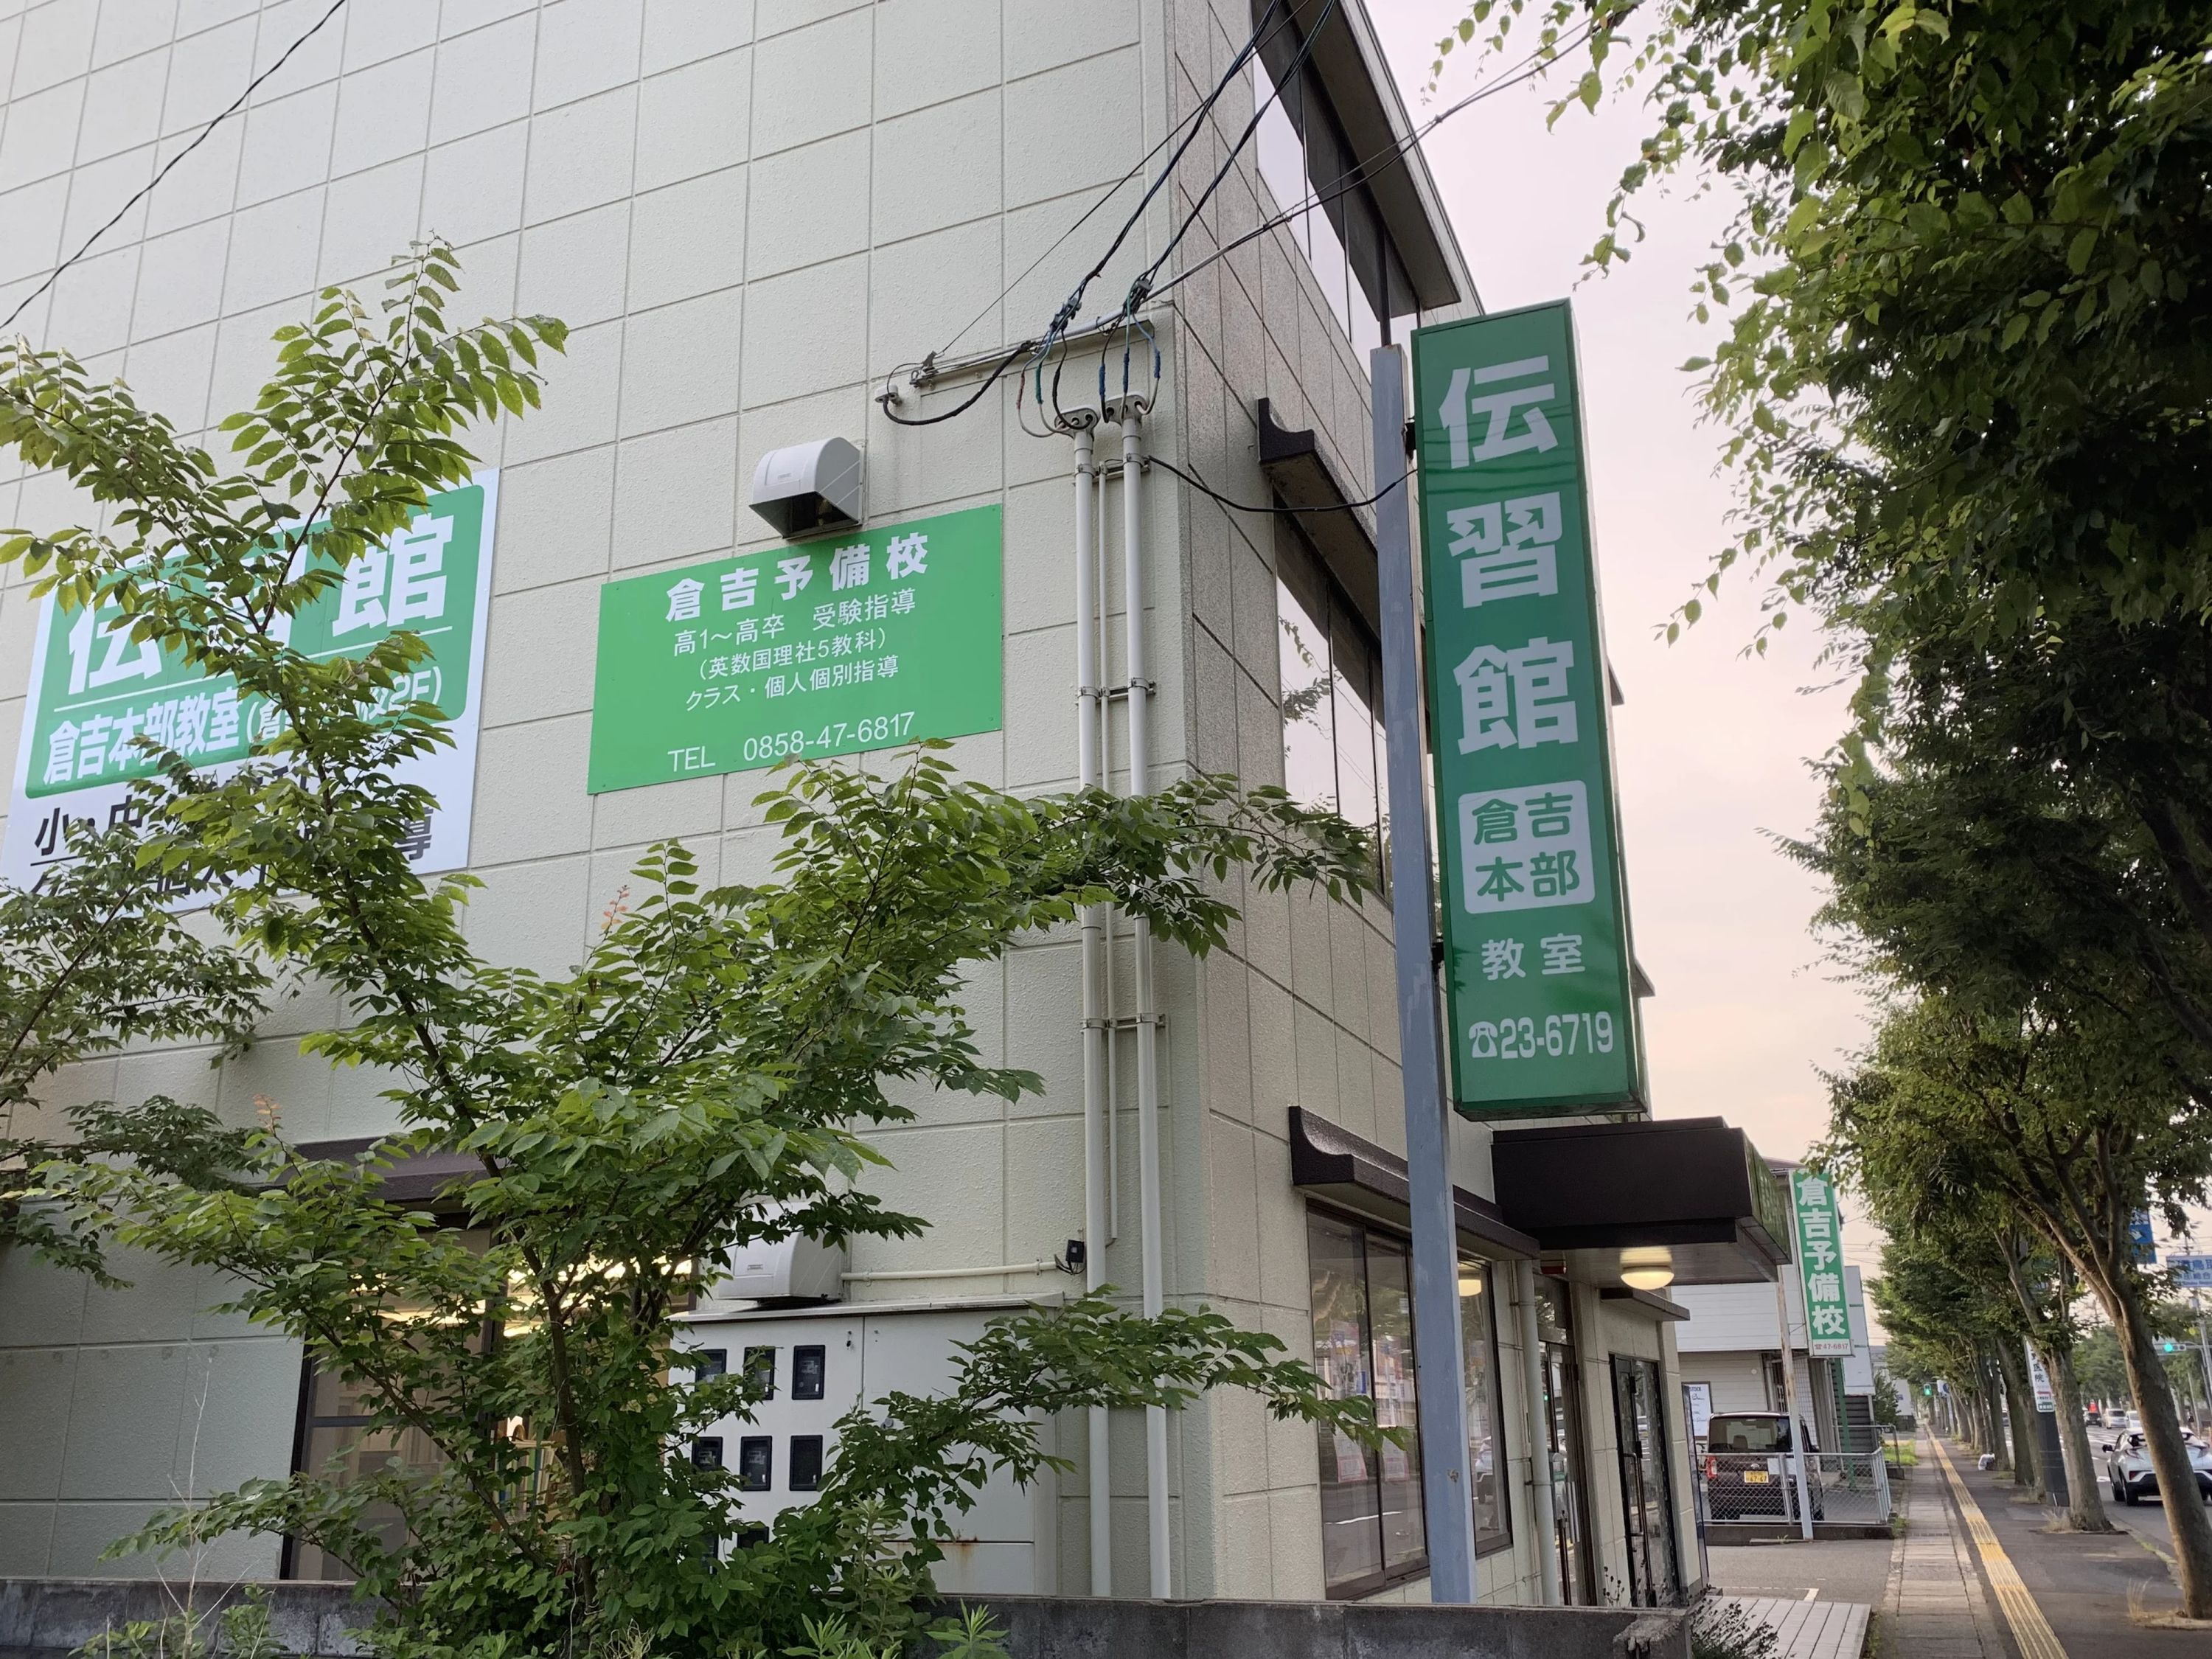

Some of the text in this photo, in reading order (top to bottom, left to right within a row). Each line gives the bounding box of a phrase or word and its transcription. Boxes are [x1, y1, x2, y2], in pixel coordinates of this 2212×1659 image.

[664, 532, 929, 622] 倉吉予備校
[1439, 355, 1578, 756] 伝習館
[813, 588, 917, 632] 受験指導
[686, 654, 899, 712] クラス・個人個別指導
[700, 629, 887, 682] (英数国理社5教科)
[667, 711, 916, 773] TEL 0858-47-6817
[1471, 791, 1573, 846] 倉吉
[1476, 849, 1581, 902] 本部
[1481, 932, 1586, 981] 教室
[1500, 1011, 1614, 1060] 23-6719
[1796, 1175, 1846, 1336] 倉吉予備校
